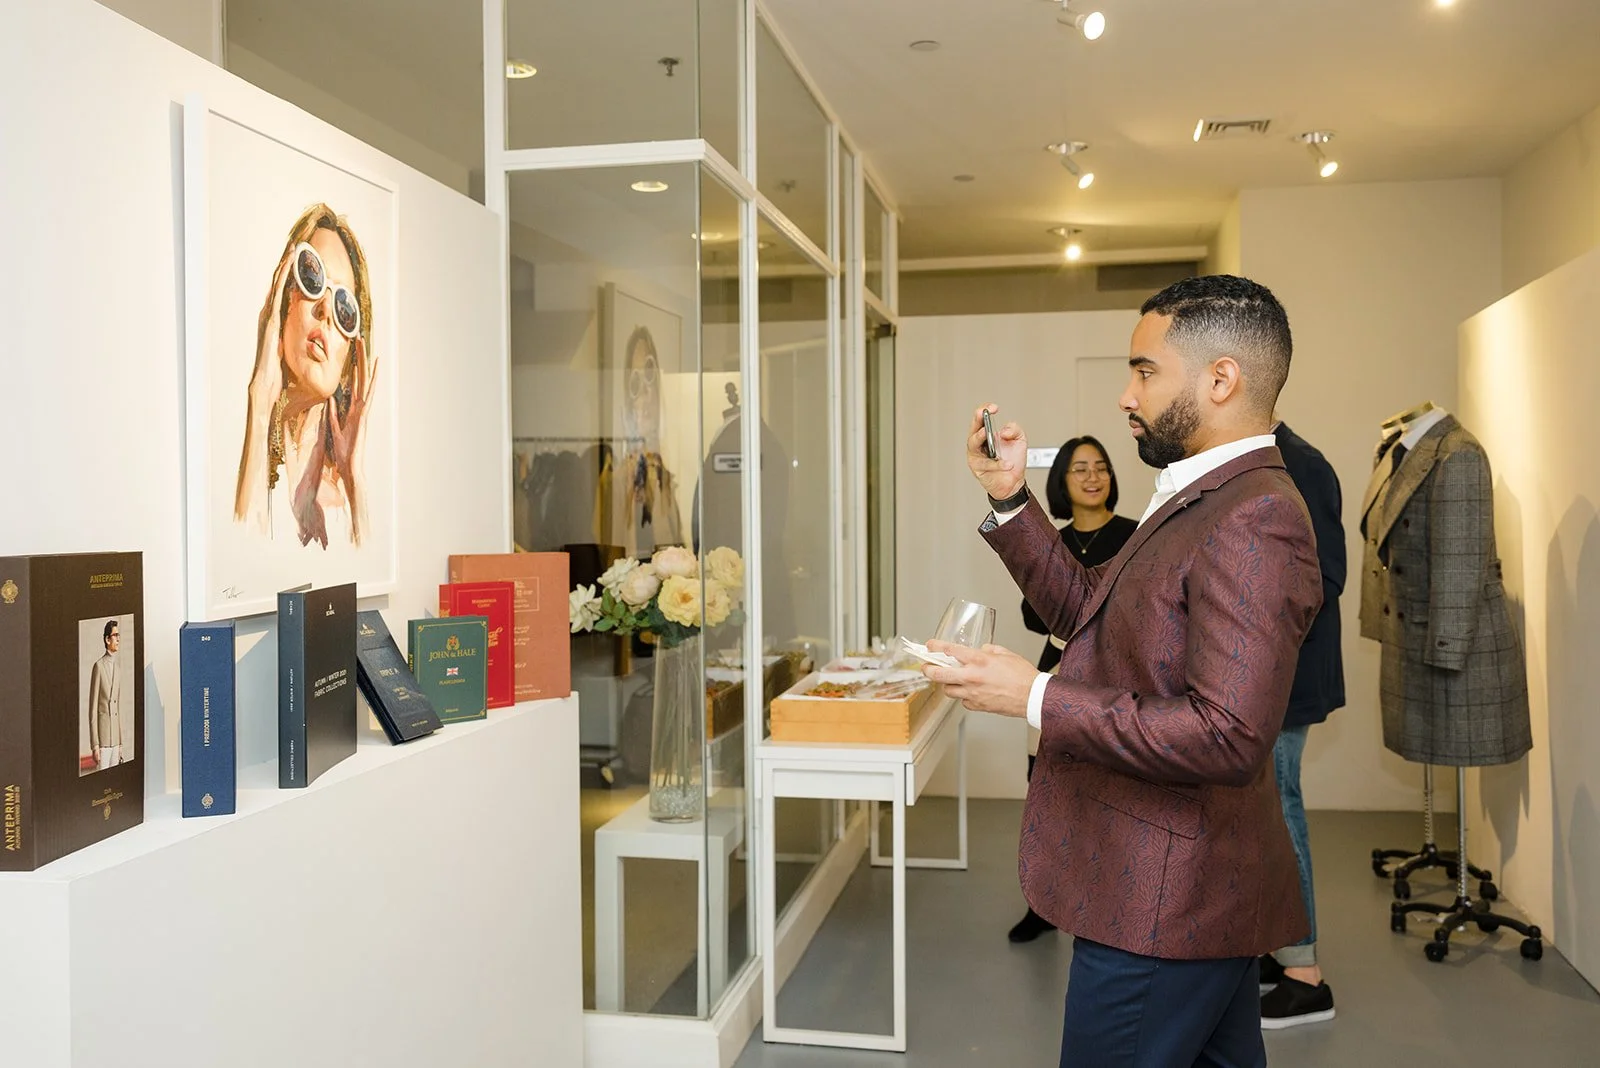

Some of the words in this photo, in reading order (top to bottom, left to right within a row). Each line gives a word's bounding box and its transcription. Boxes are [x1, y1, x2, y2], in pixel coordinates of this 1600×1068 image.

[90, 573, 124, 583] ANTEPRIMA
[428, 650, 450, 662] JOHN
[457, 647, 478, 658] HALE
[4, 784, 15, 850] ANTEPRIMA
